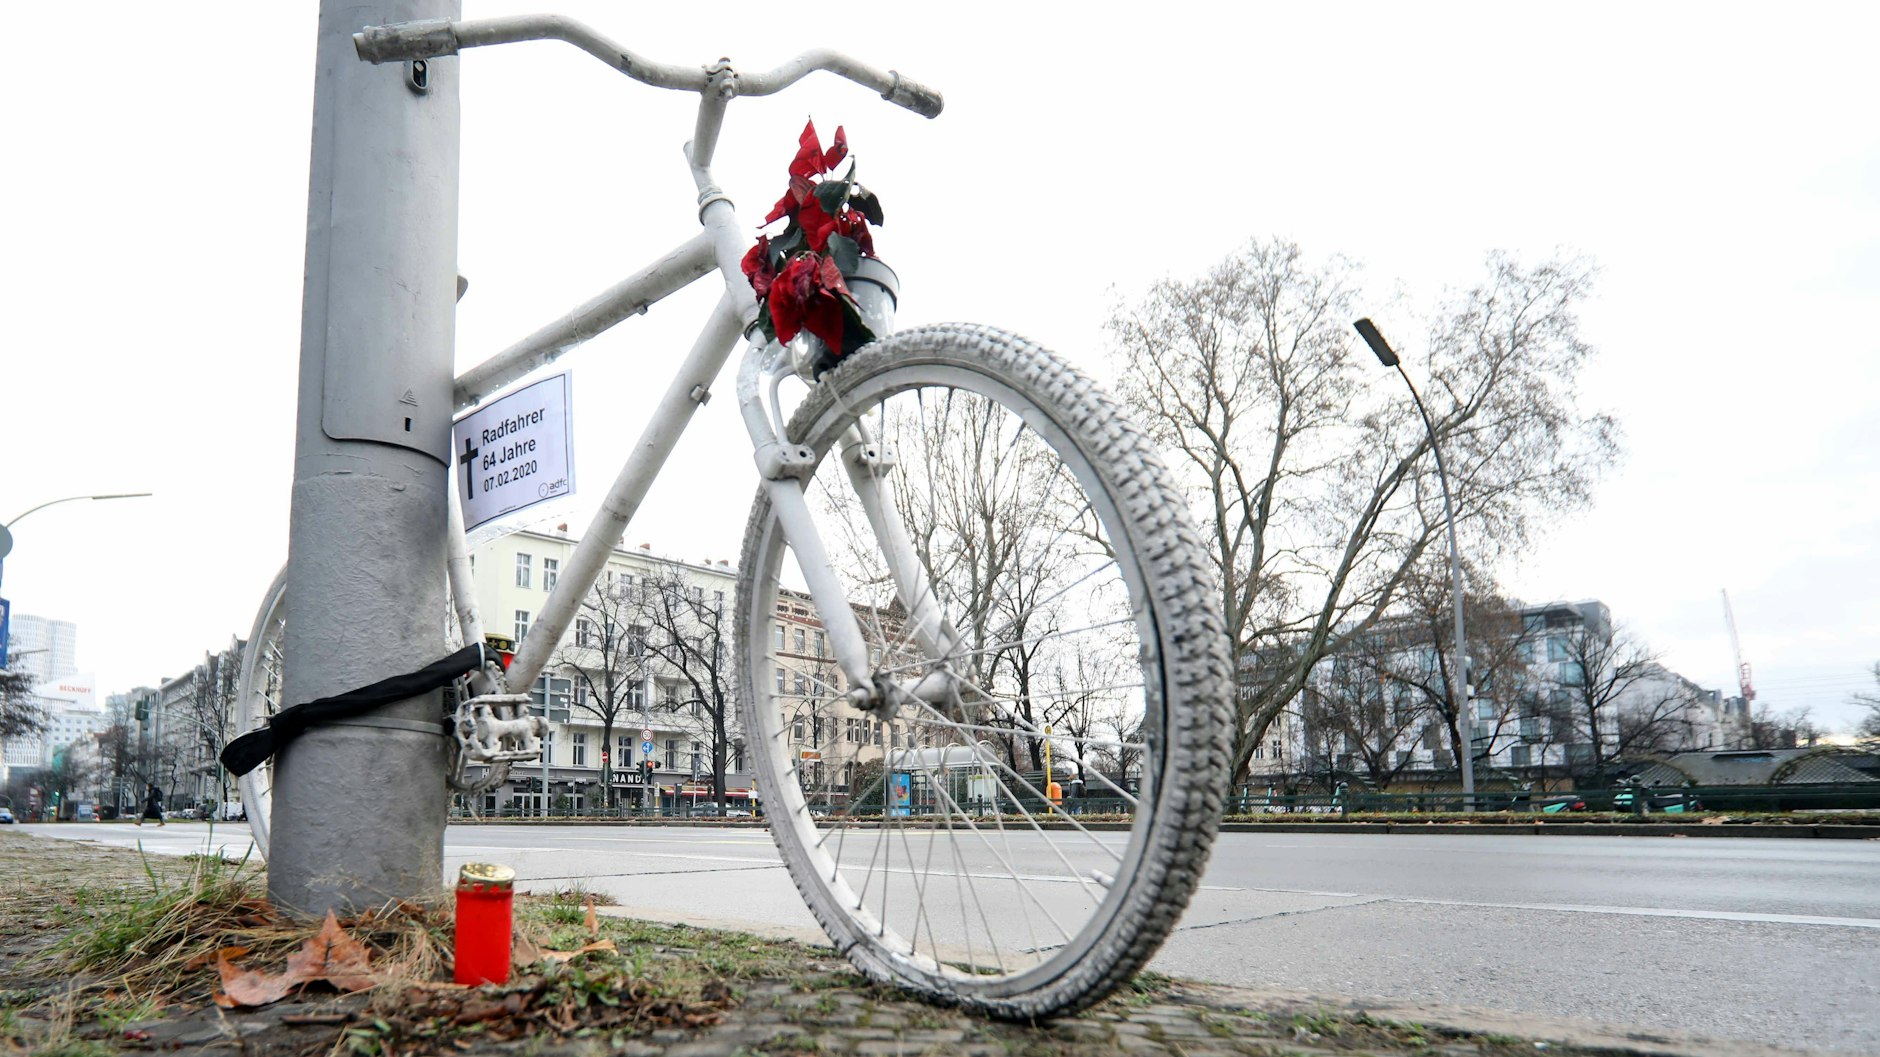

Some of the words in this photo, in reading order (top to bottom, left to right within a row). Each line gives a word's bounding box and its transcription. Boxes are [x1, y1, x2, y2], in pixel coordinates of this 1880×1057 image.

[482, 408, 545, 446] Radfahrer
[483, 453, 496, 471] 64
[500, 439, 536, 464] Jahre
[484, 460, 537, 492] 07.02.2020
[549, 478, 567, 490] adfc
[610, 773, 645, 783] NAND
